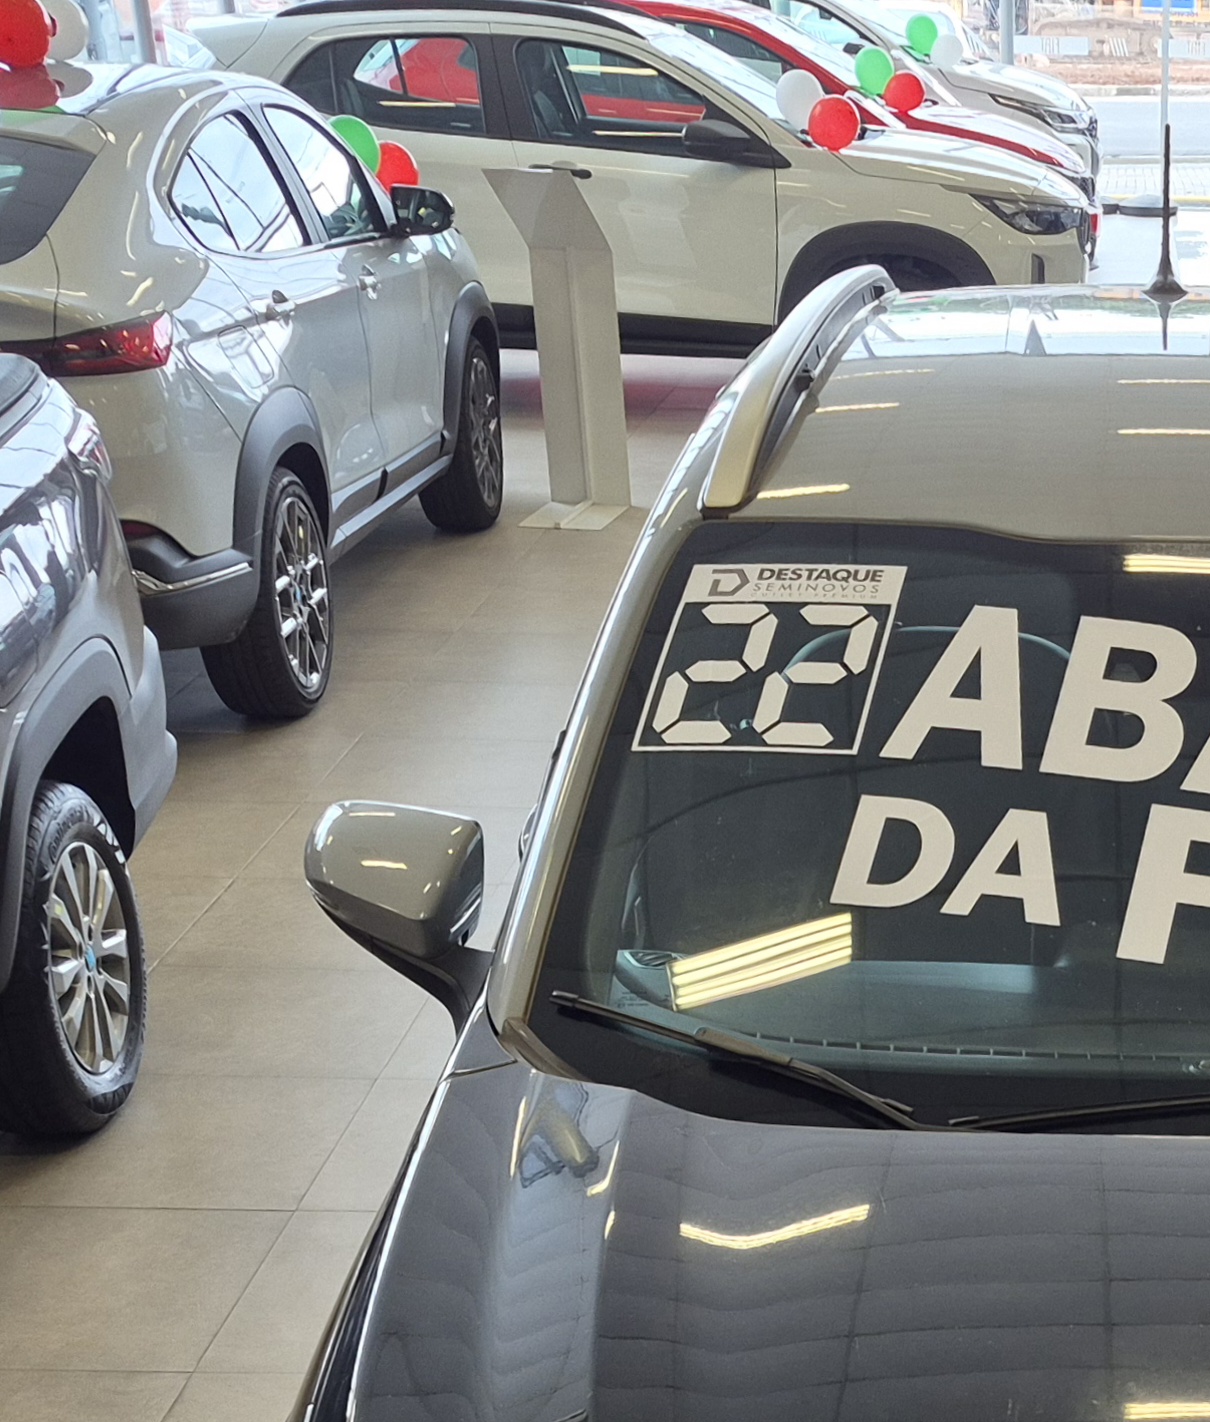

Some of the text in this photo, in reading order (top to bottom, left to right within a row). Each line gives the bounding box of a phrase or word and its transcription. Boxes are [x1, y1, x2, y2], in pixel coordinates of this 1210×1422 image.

[752, 582, 880, 594] SEMINOVOS
[757, 568, 884, 583] DESTAQUE
[652, 603, 878, 747] 22
[829, 794, 1061, 926] DA
